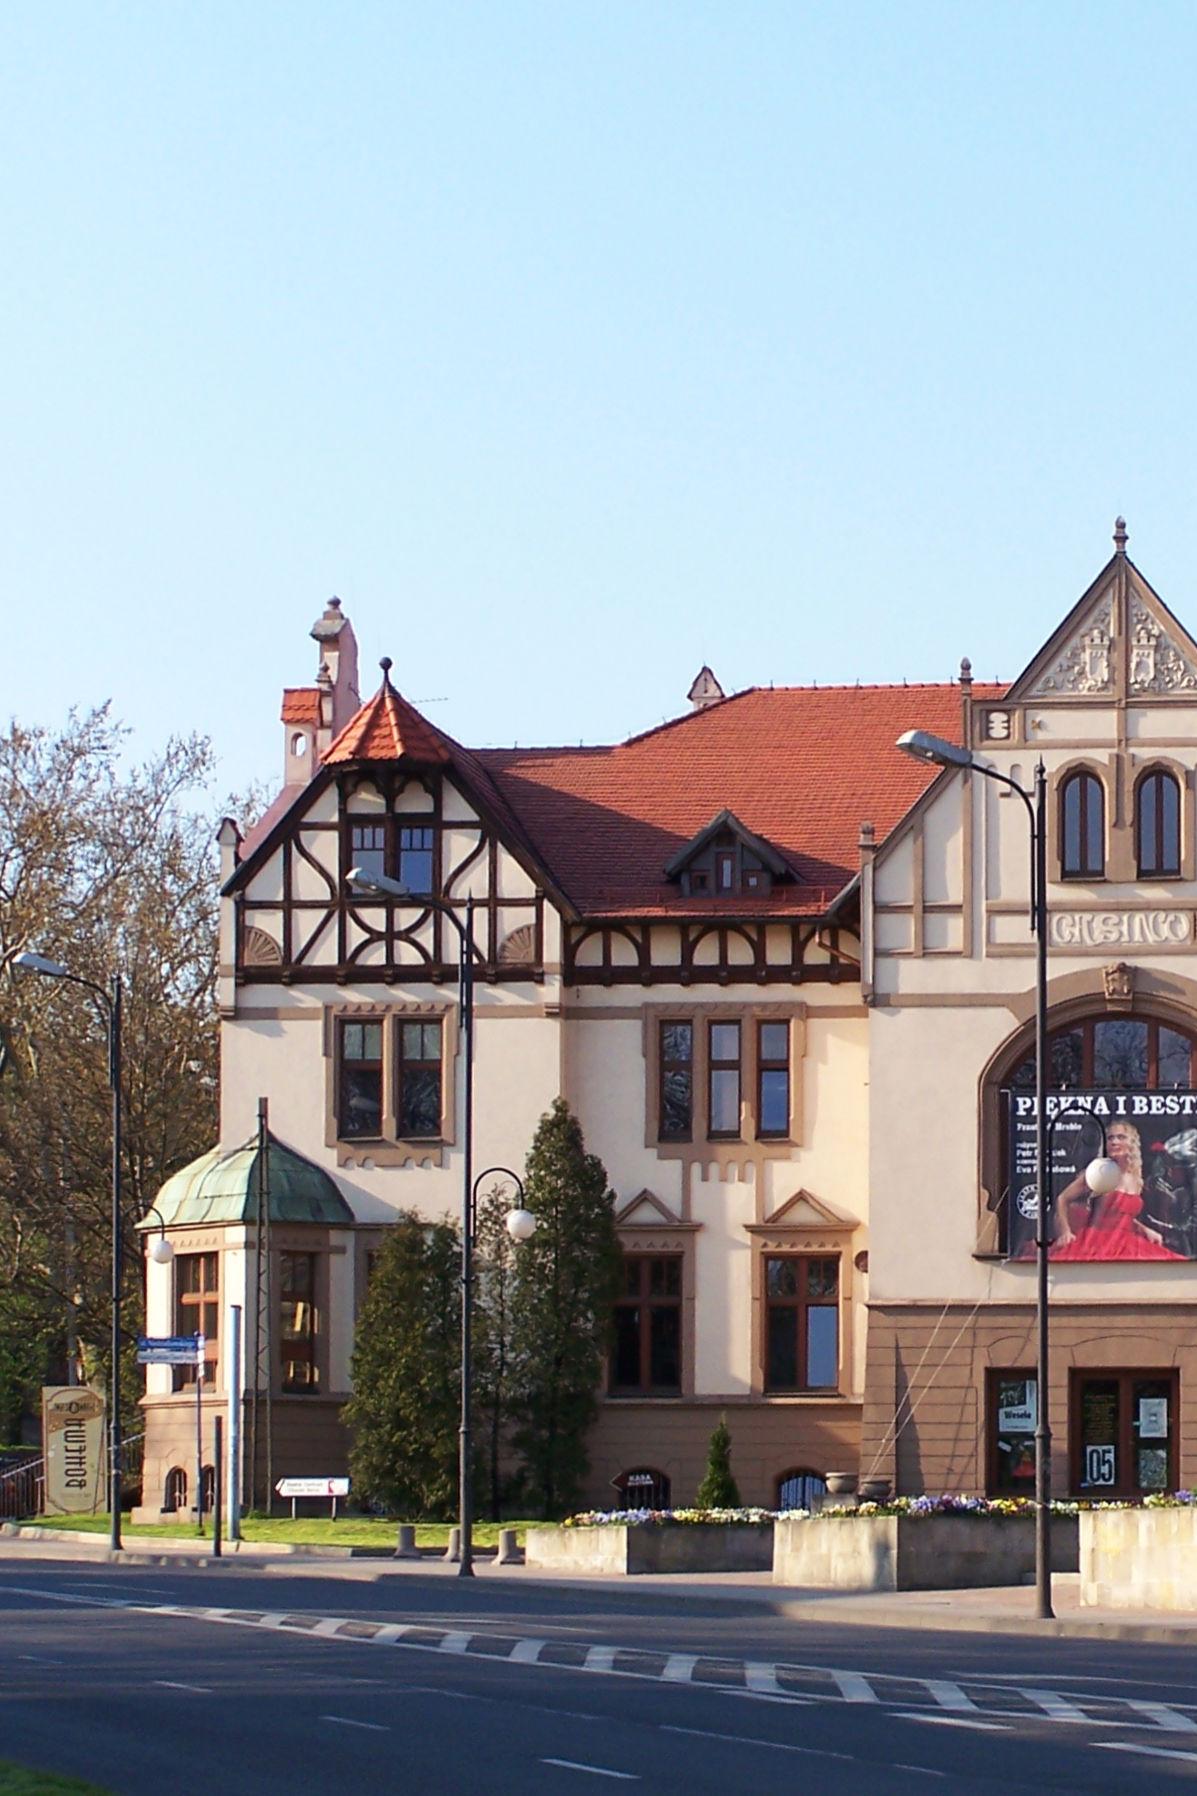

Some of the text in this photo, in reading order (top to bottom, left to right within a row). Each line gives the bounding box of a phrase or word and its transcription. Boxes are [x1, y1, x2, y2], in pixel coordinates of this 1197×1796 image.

[1051, 911, 1191, 946] CASINO
[1115, 1096, 1127, 1115] I
[64, 1418, 87, 1490] BOHEMA
[1089, 1448, 1113, 1482] 05
